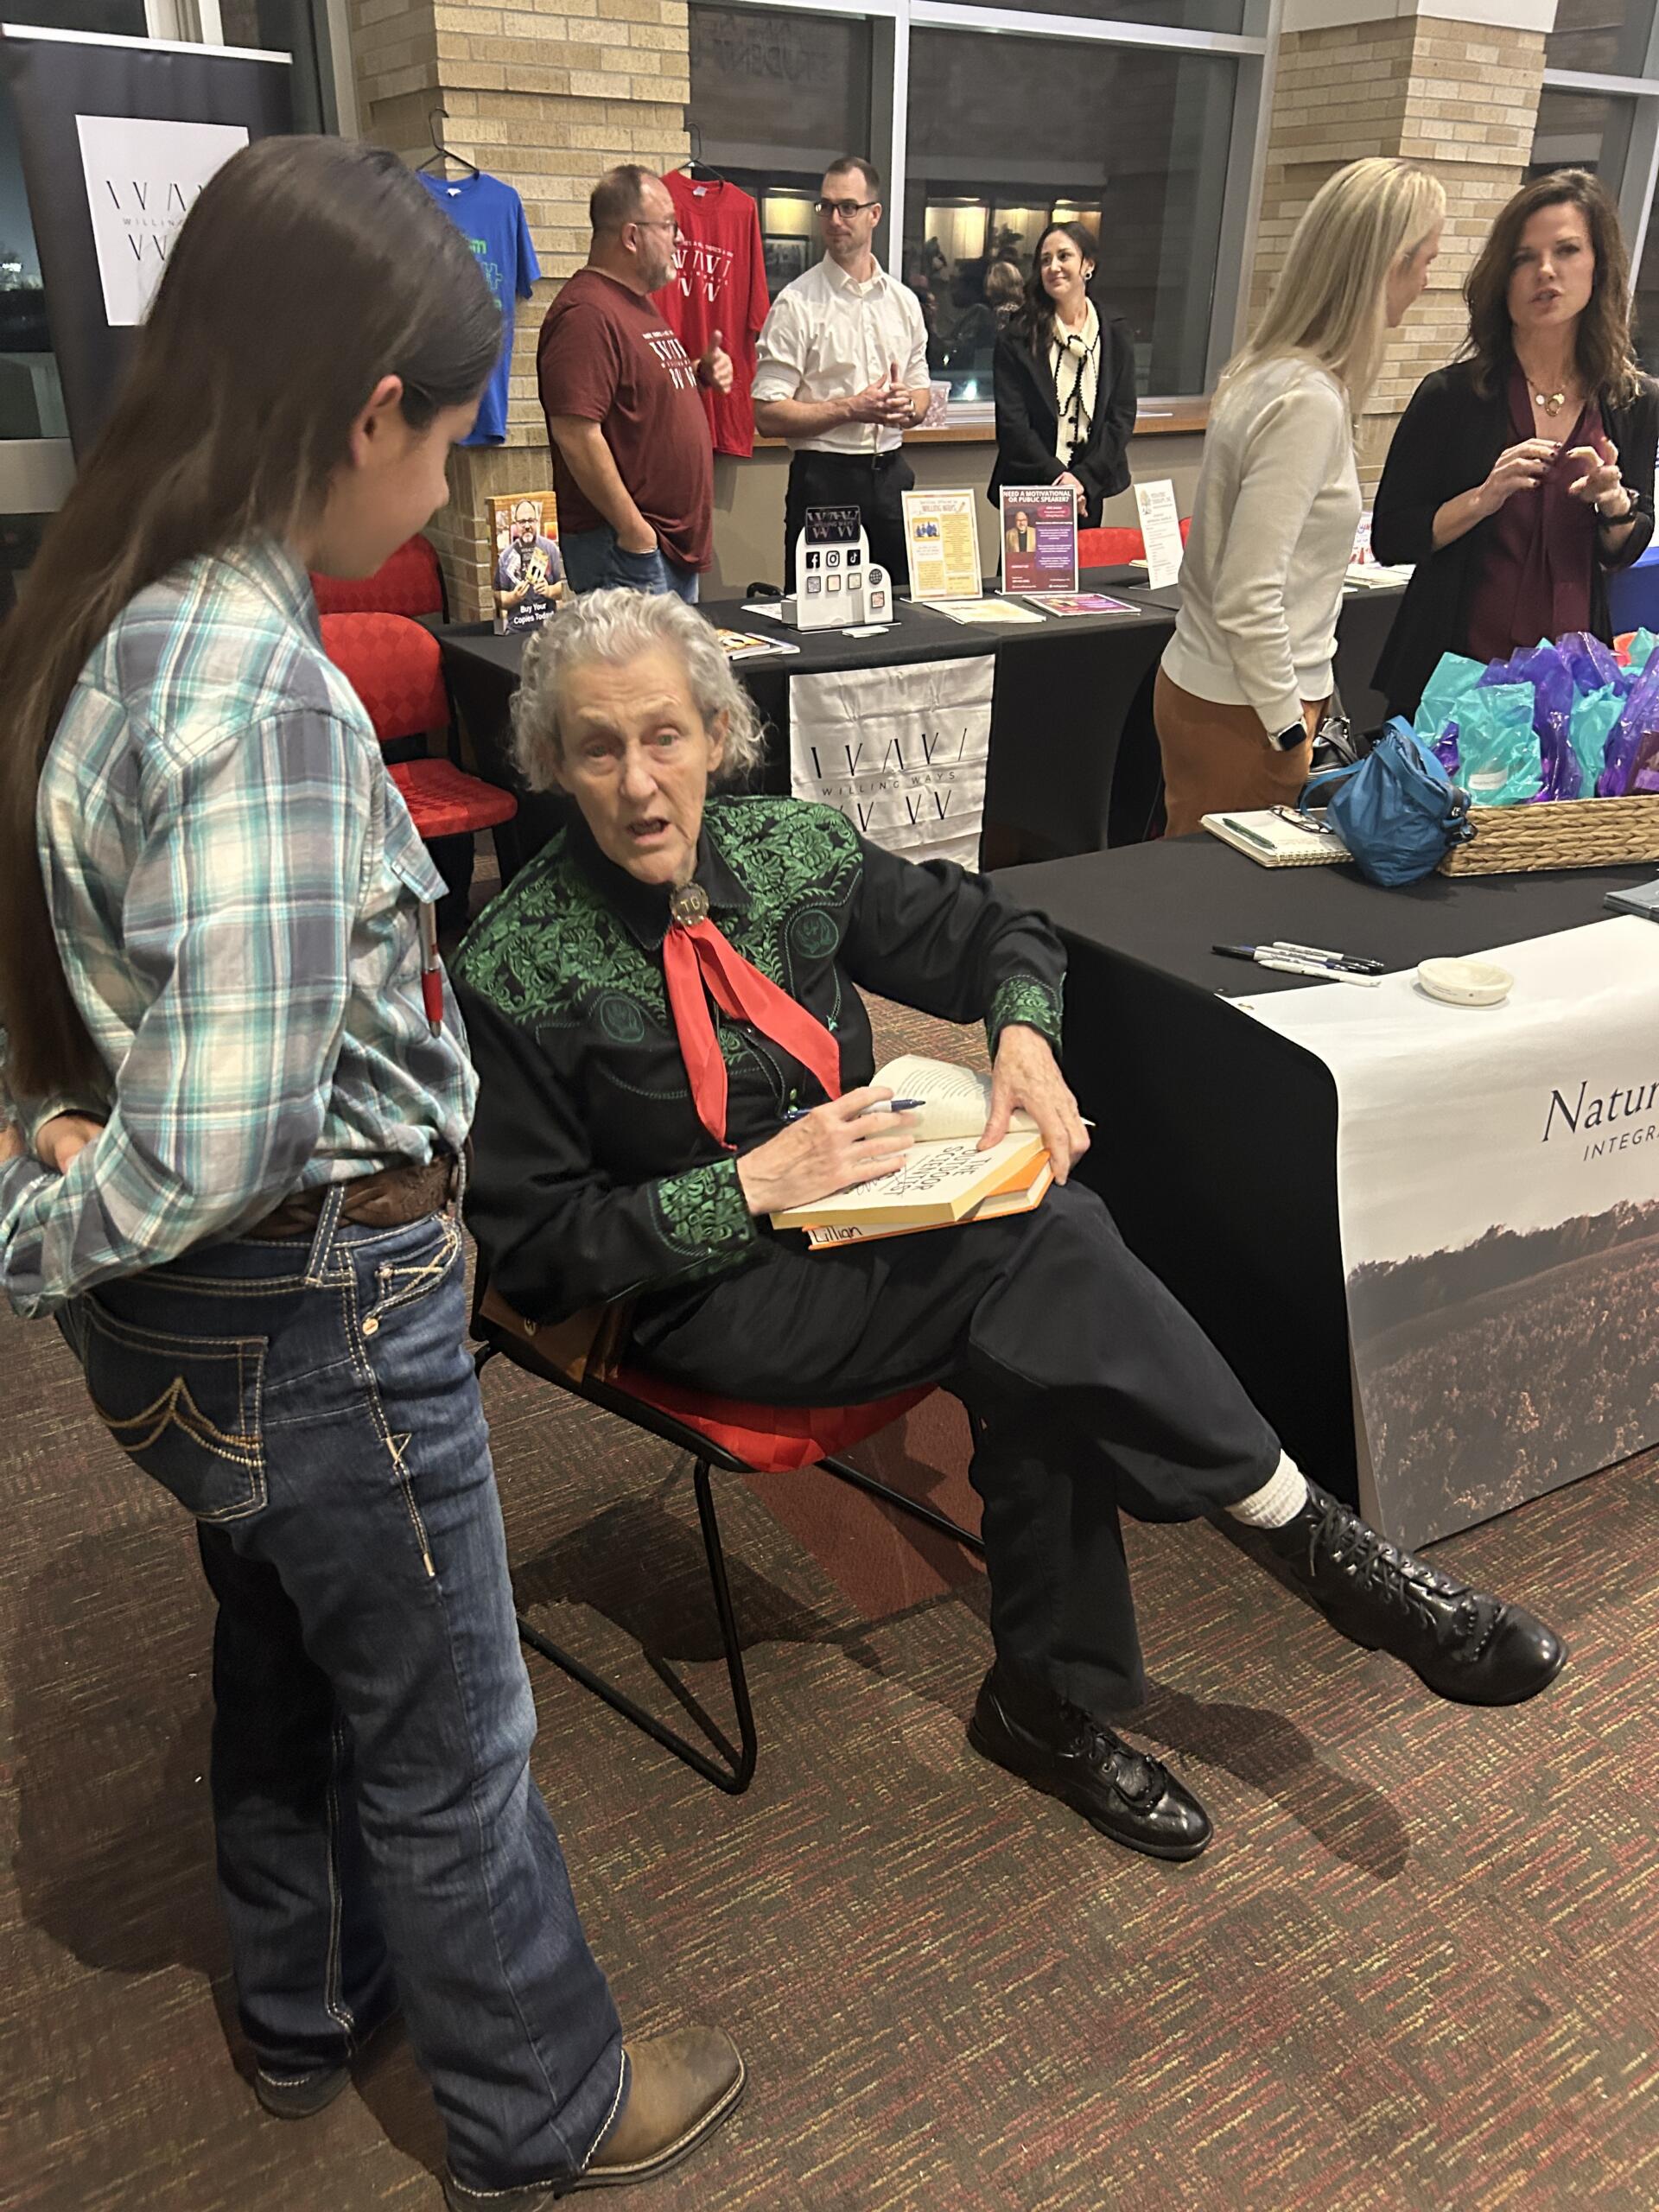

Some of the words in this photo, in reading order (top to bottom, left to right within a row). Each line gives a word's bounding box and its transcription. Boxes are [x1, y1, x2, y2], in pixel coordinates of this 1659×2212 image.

[514, 614, 535, 625] Copies
[520, 605, 532, 613] Buy
[822, 781, 899, 797] WILLING
[912, 771, 956, 785] WAYS
[1583, 1125, 1659, 1161] INTEGR
[883, 1146, 964, 1196] SCIENTIST
[911, 1148, 982, 1191] OUTDOOR
[952, 1157, 992, 1177] THE
[811, 1225, 863, 1243] Lillian
